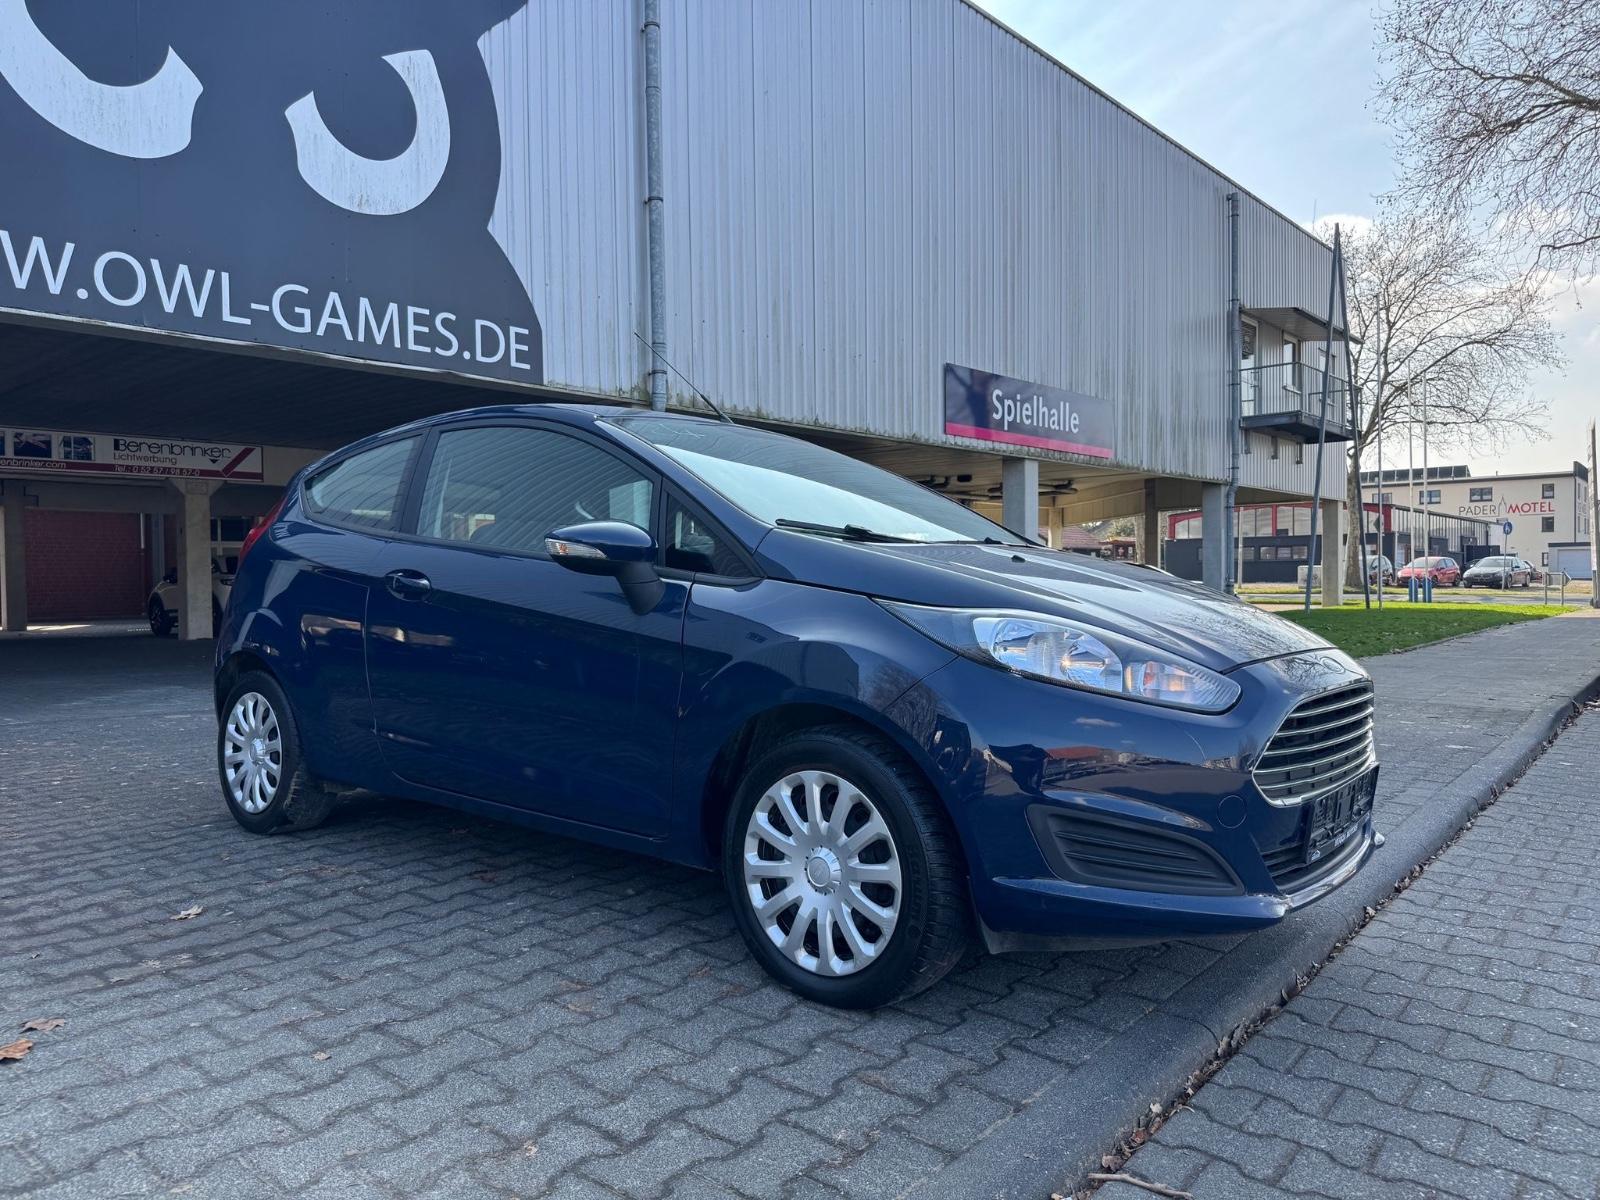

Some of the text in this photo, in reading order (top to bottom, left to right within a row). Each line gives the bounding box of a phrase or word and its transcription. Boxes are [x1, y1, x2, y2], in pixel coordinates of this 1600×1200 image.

[0, 229, 531, 370] W.OWL-GAMES.DE
[992, 388, 1080, 434] Spielhalle
[113, 438, 232, 459] Berenbrinker
[113, 452, 177, 465] Lichtwerbung
[1458, 501, 1556, 516] PADER MOTEL
